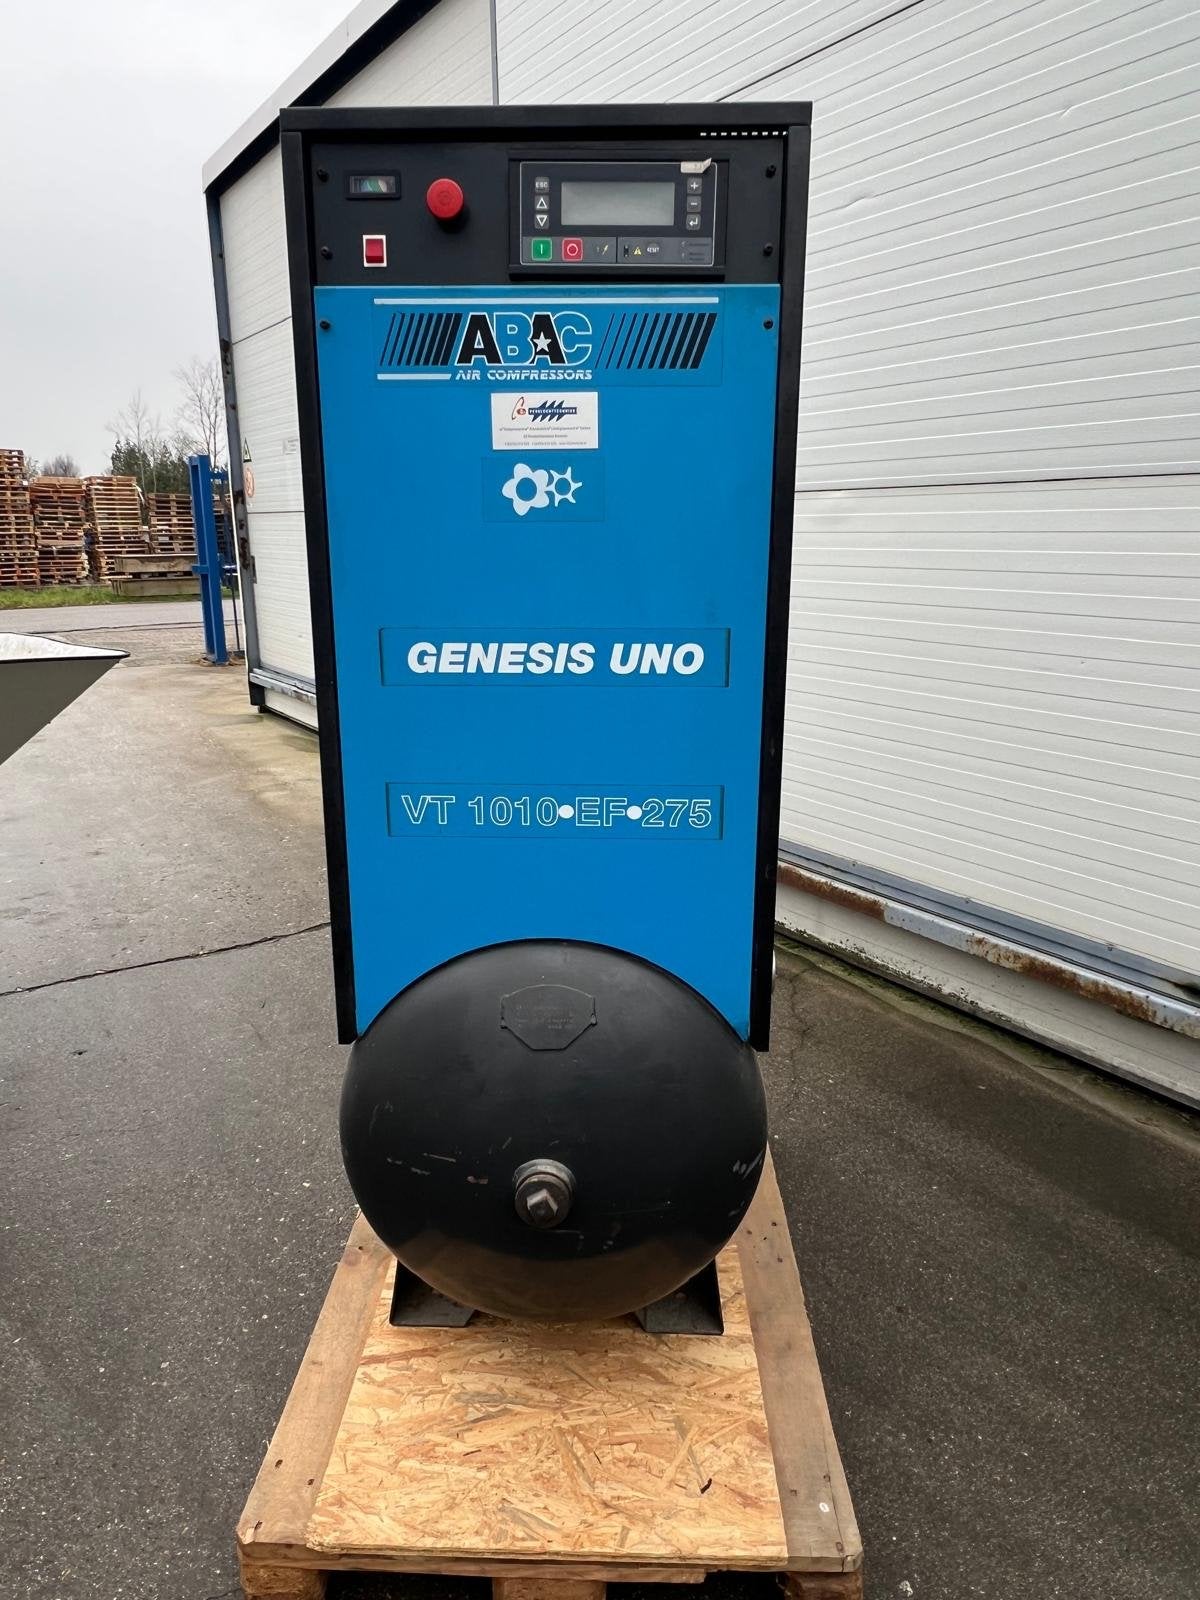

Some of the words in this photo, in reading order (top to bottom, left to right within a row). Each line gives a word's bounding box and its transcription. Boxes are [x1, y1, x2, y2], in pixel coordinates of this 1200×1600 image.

[454, 311, 592, 366] ABAC
[455, 370, 481, 380] AIR
[487, 369, 593, 380] COMPRESSORS
[407, 642, 595, 674] GENESIS
[609, 643, 704, 674] UNO
[401, 795, 455, 824] VT
